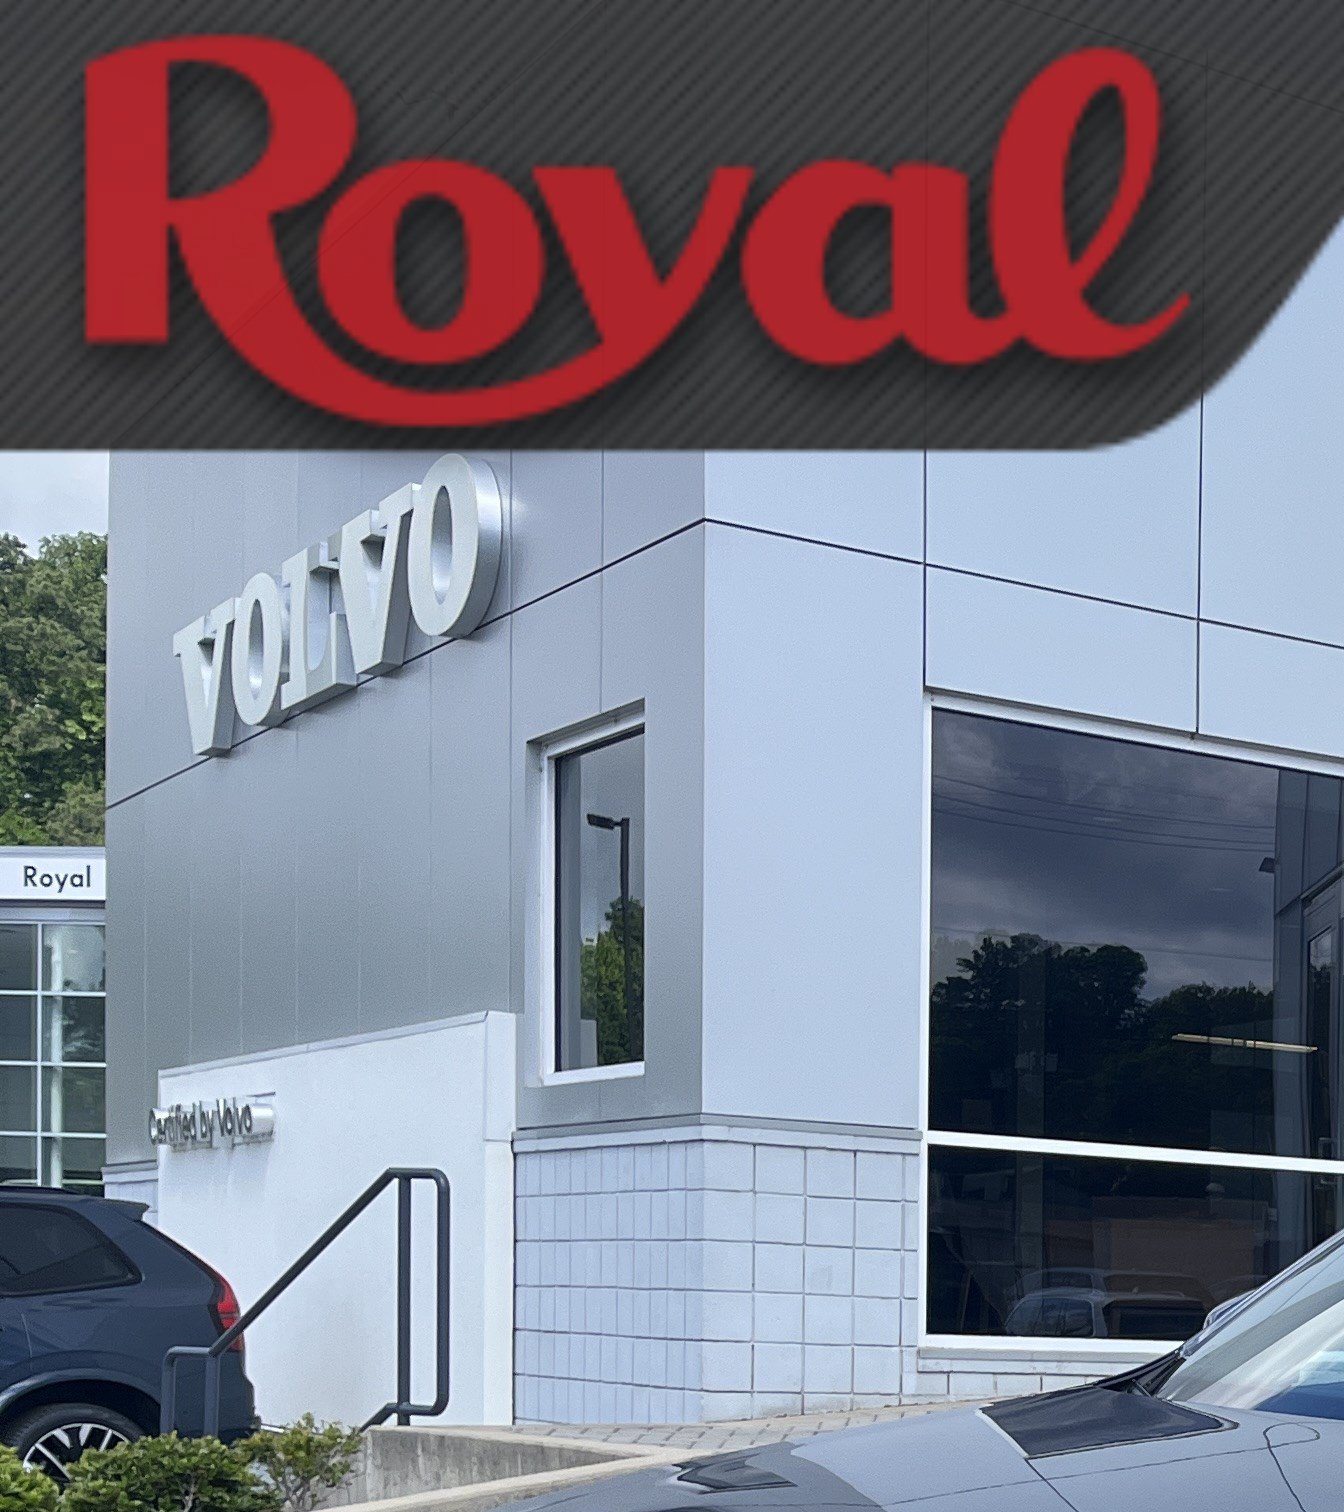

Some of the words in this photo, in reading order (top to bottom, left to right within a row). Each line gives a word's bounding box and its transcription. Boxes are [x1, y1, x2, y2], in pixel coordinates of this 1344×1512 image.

[173, 453, 496, 756] VOLVO
[23, 865, 91, 893] Royal
[216, 1096, 252, 1138] Volvo
